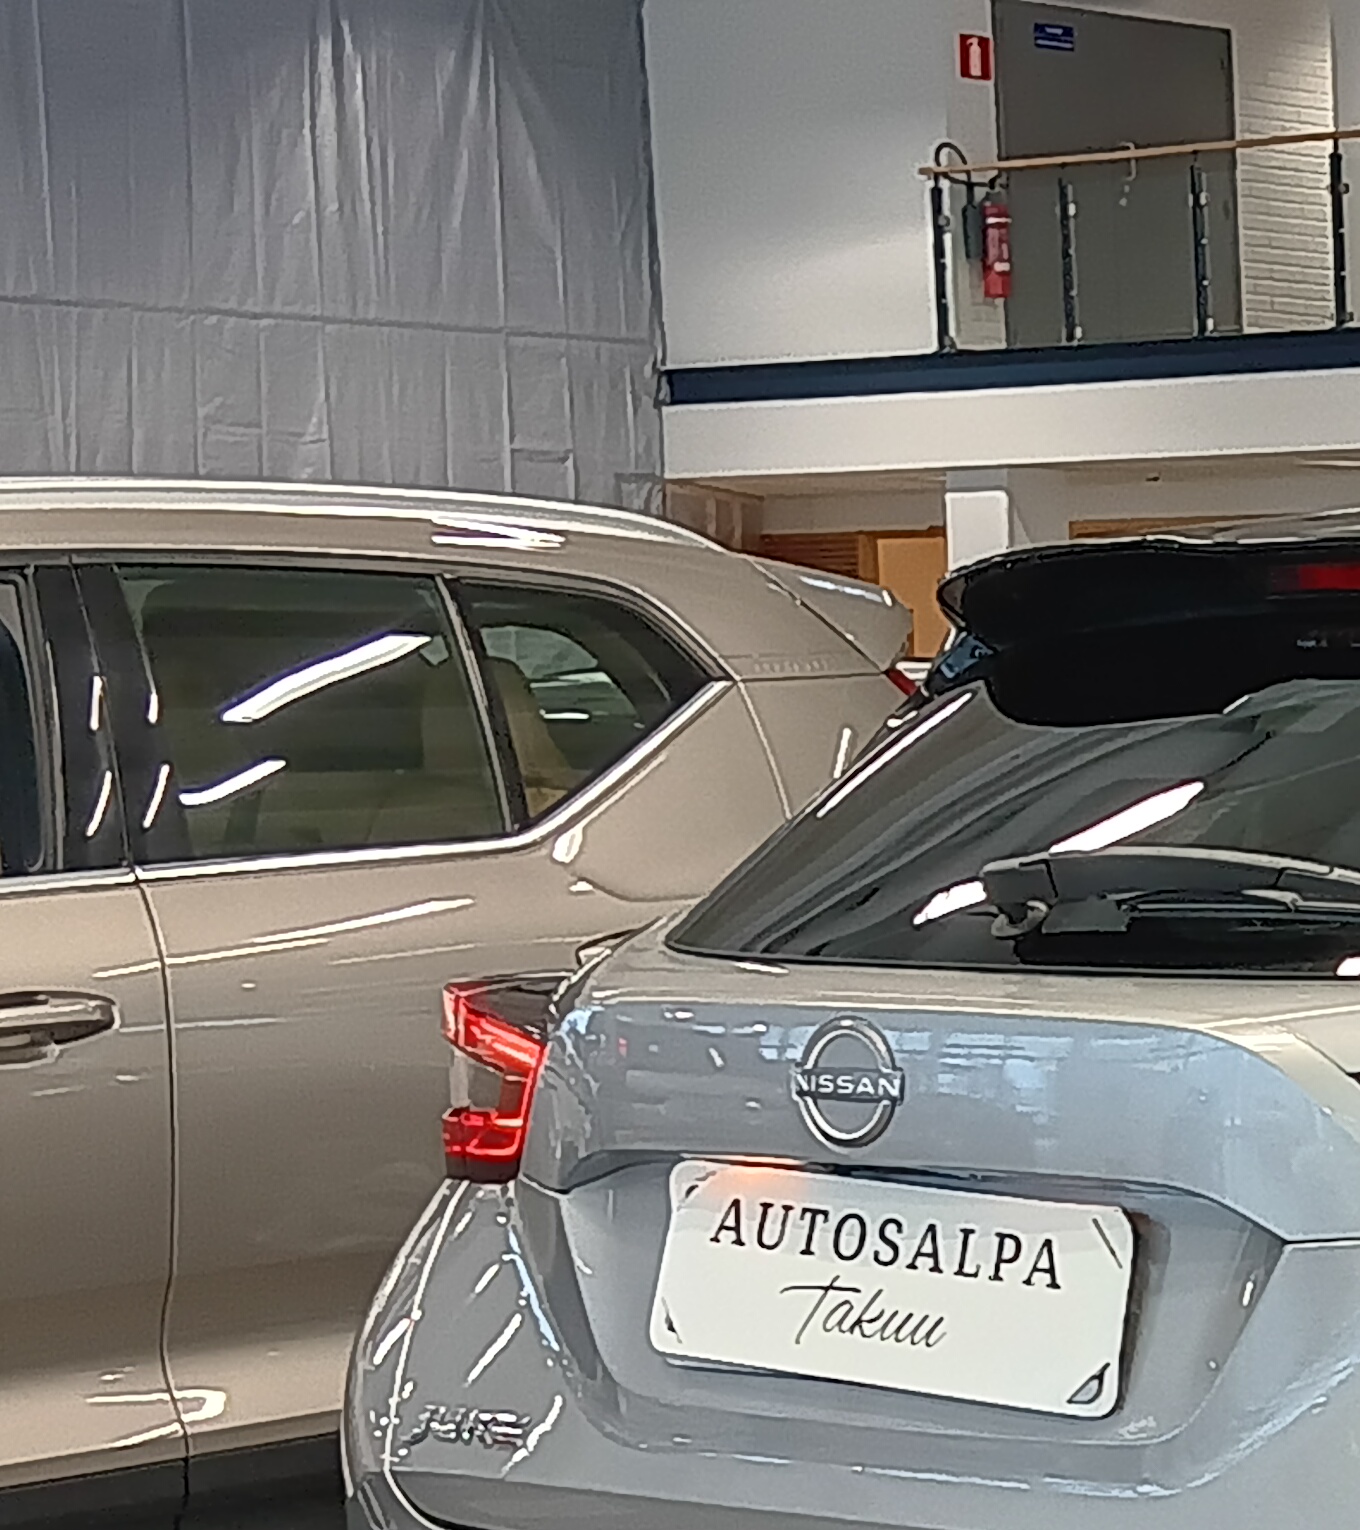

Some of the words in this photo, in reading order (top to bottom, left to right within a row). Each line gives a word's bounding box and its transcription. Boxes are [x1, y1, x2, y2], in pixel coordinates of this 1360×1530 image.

[795, 1073, 901, 1097] NISSAN
[710, 1198, 1062, 1290] AUTOSALPA
[779, 1275, 948, 1348] Takuu
